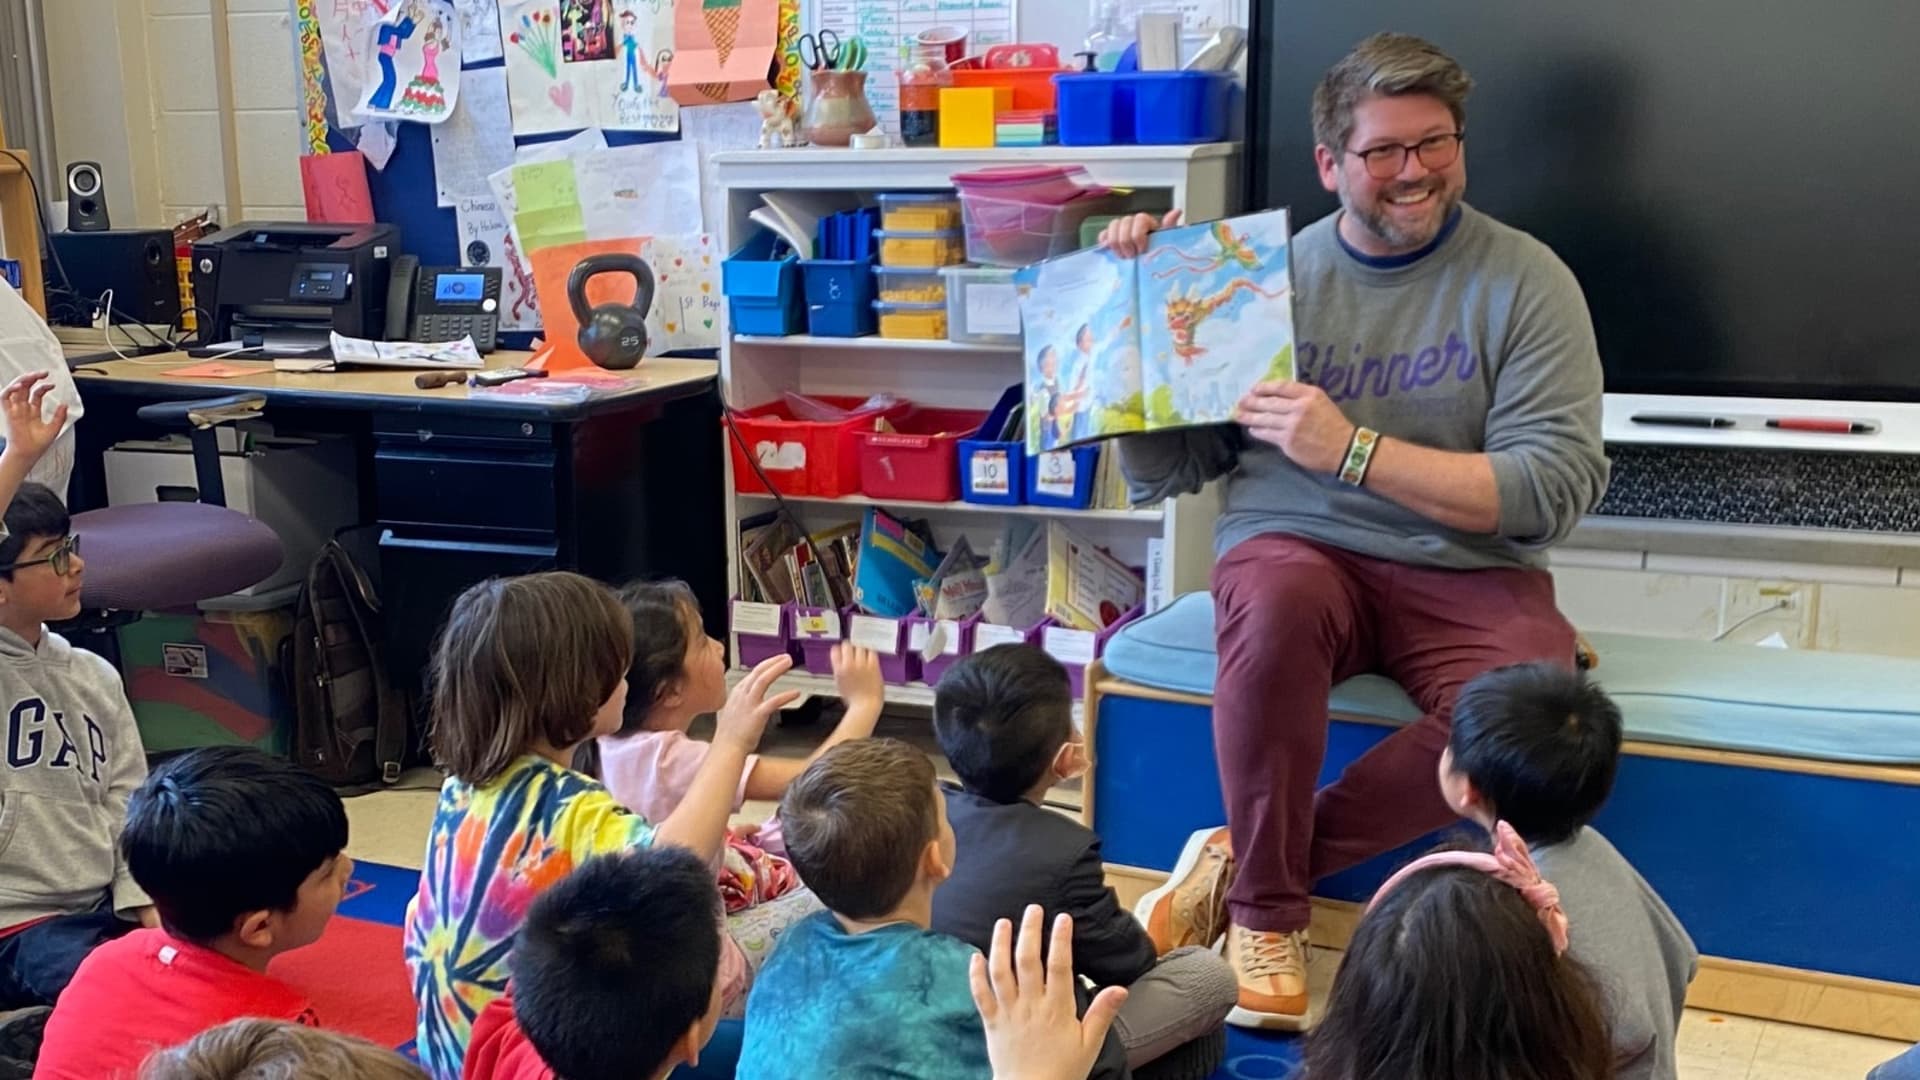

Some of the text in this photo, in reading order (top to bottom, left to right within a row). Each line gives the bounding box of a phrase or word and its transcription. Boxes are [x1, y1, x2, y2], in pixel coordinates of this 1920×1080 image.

[621, 336, 640, 347] 25
[983, 463, 998, 479] 10
[1049, 456, 1062, 476] 3
[7, 697, 106, 783] GAP
